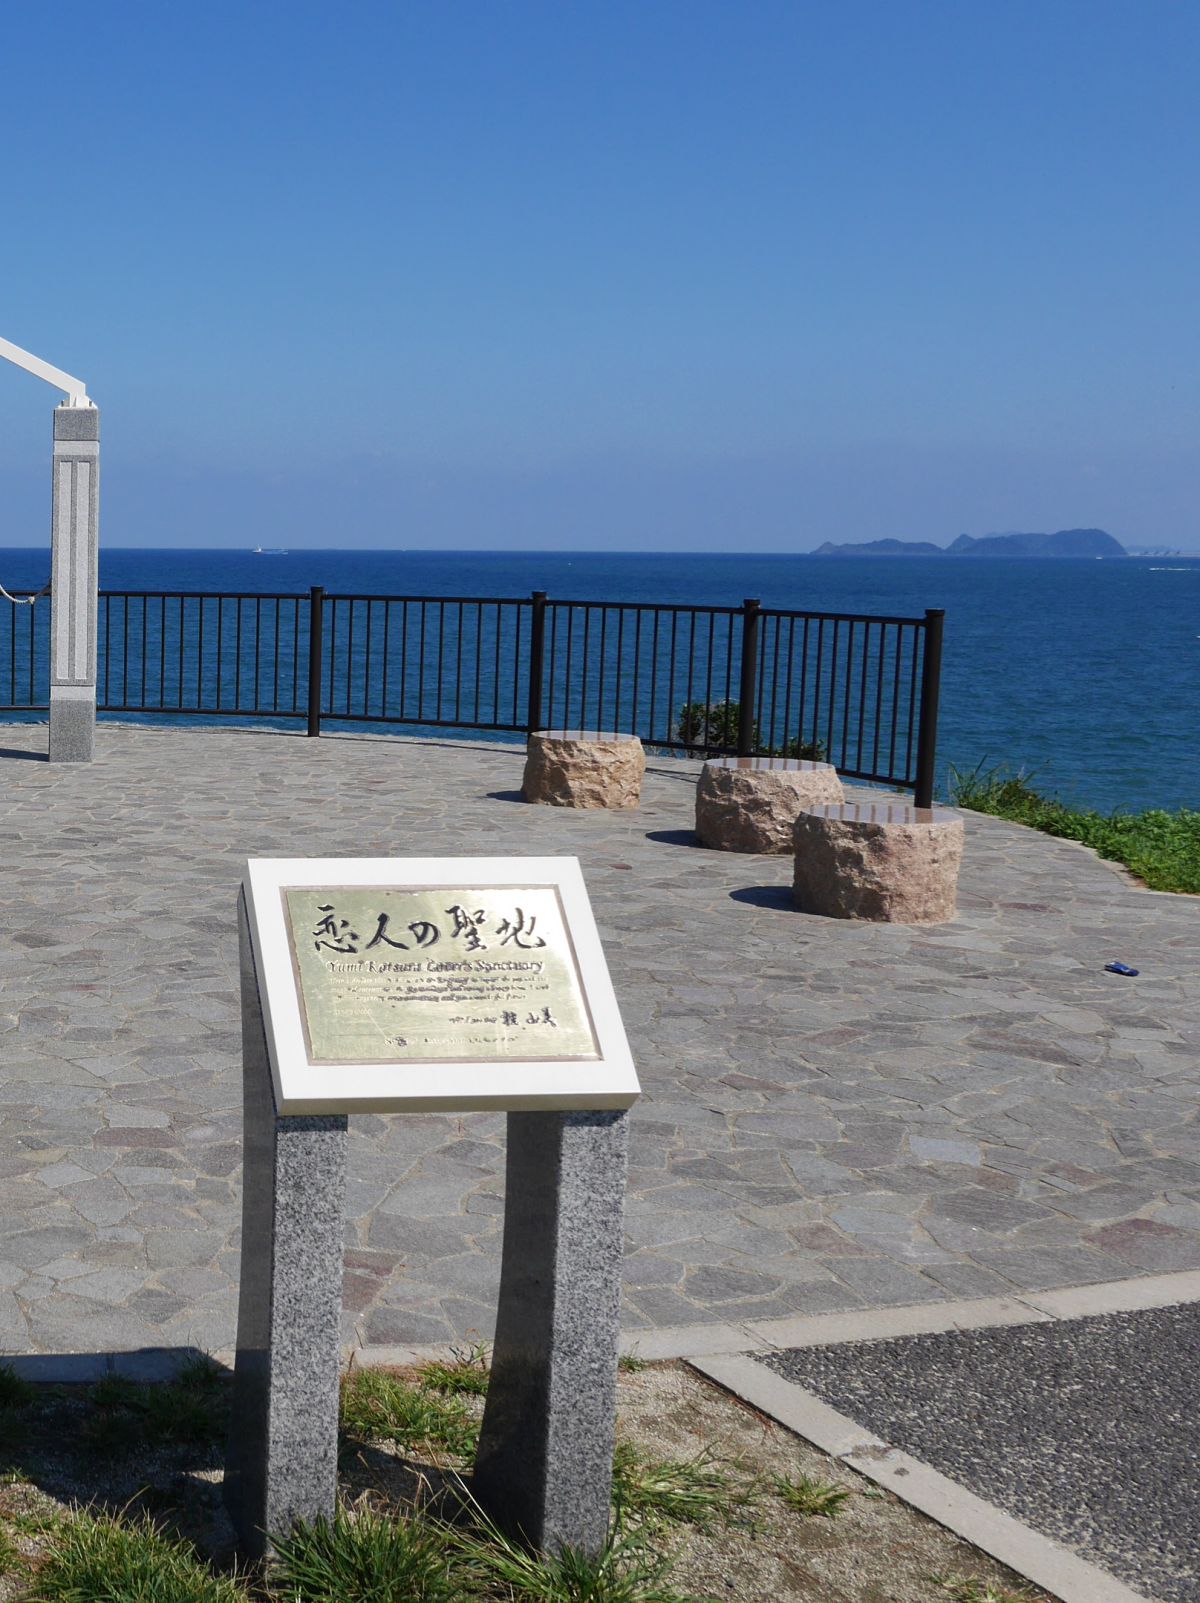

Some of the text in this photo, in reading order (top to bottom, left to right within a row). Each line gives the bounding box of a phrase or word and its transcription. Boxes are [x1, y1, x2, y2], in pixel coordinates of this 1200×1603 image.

[312, 904, 547, 953] 恋人の聖地
[327, 960, 363, 973] Yumi
